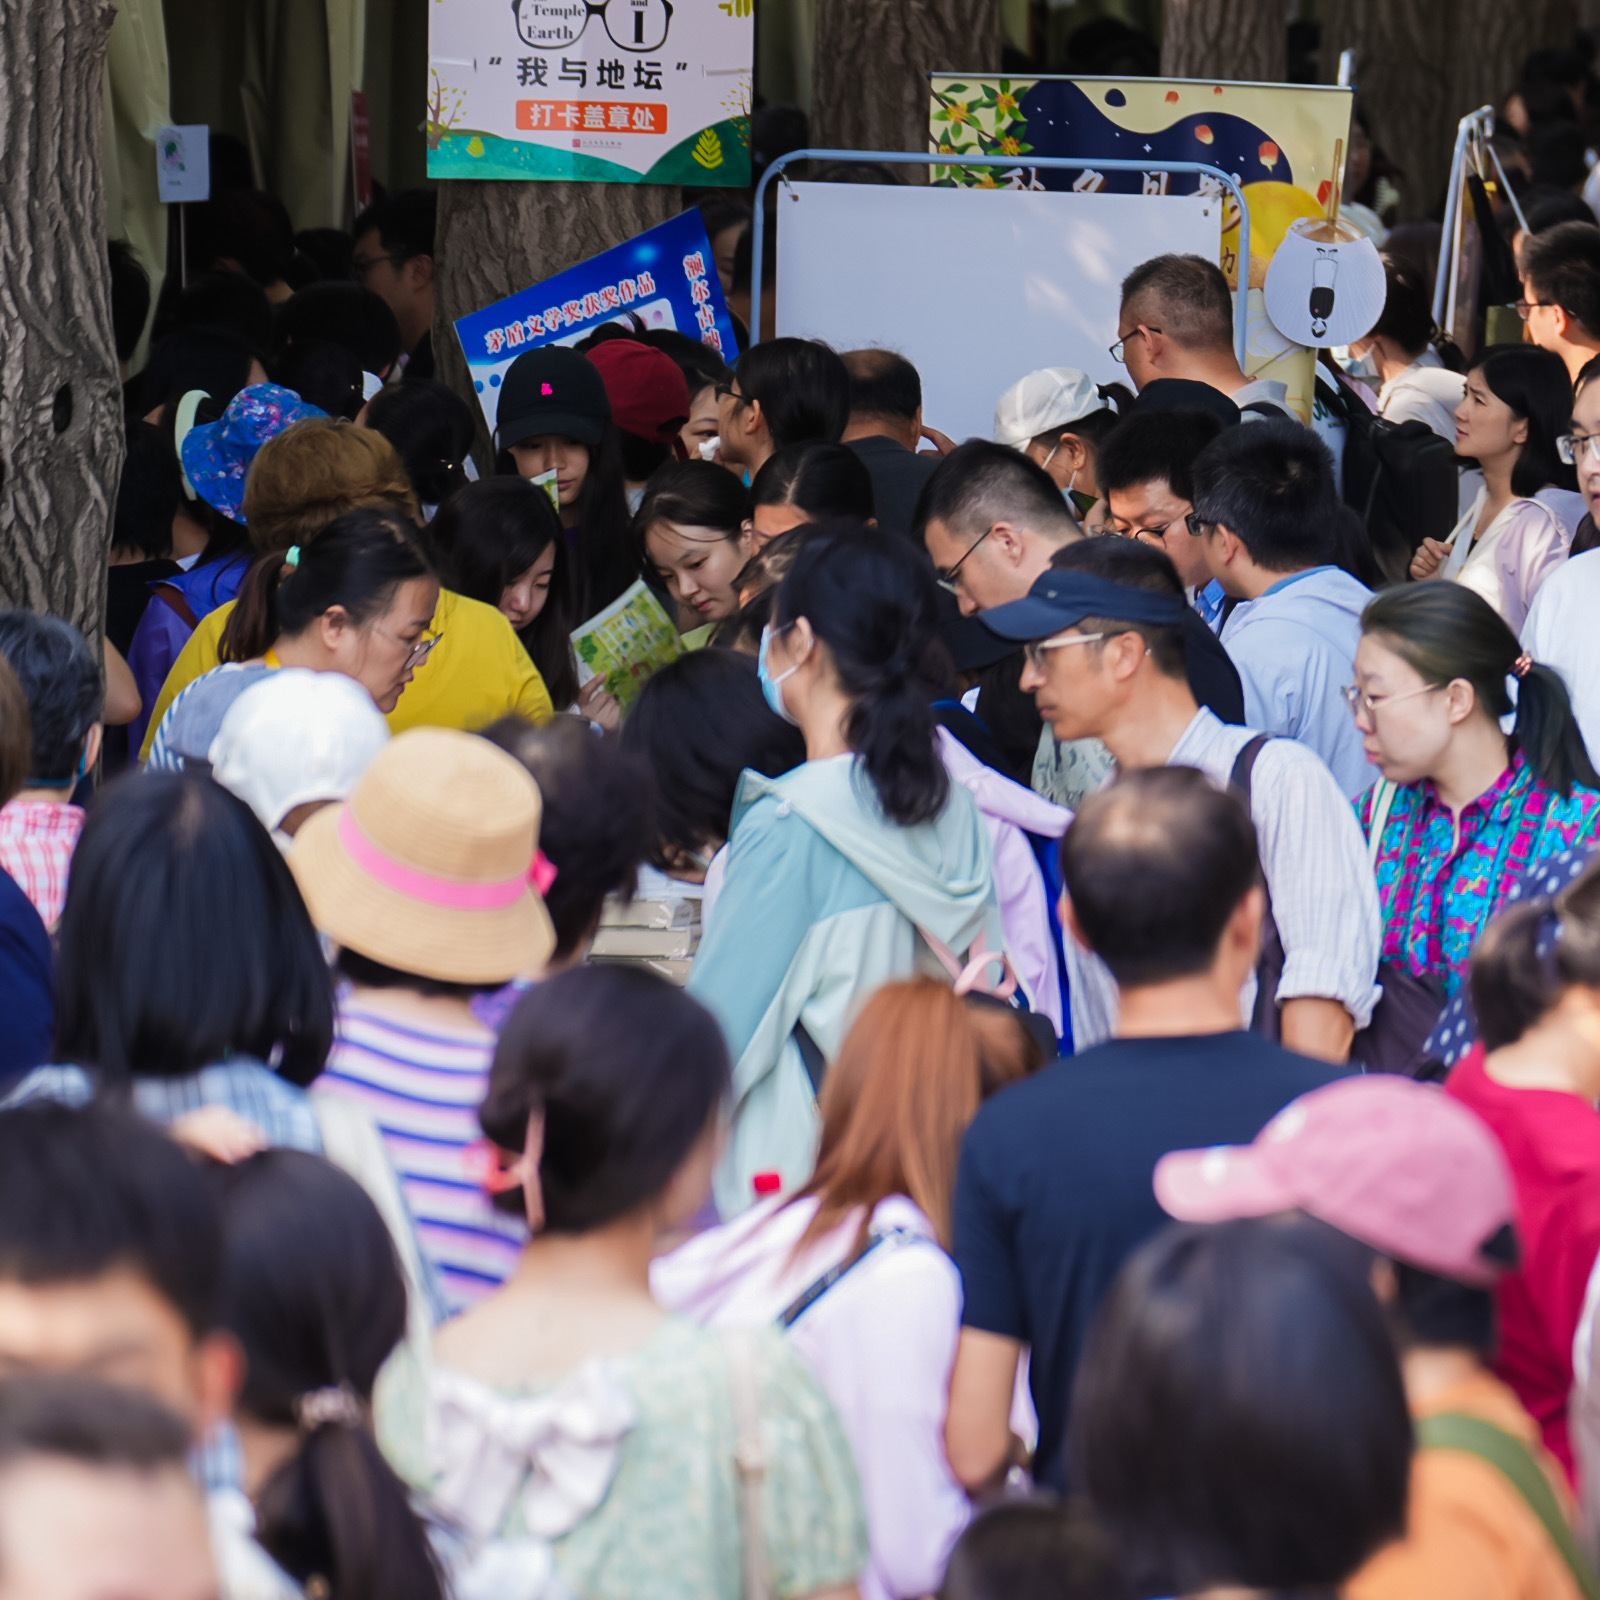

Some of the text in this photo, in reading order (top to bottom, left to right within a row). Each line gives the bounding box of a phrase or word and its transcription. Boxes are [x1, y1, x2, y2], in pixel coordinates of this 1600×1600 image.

[532, 4, 586, 20] Temple
[527, 25, 574, 40] Earth
[632, 10, 646, 44] I
[530, 103, 655, 131] 打卡盖章处
[484, 271, 656, 355] 茅盾文学奖获奖作品
